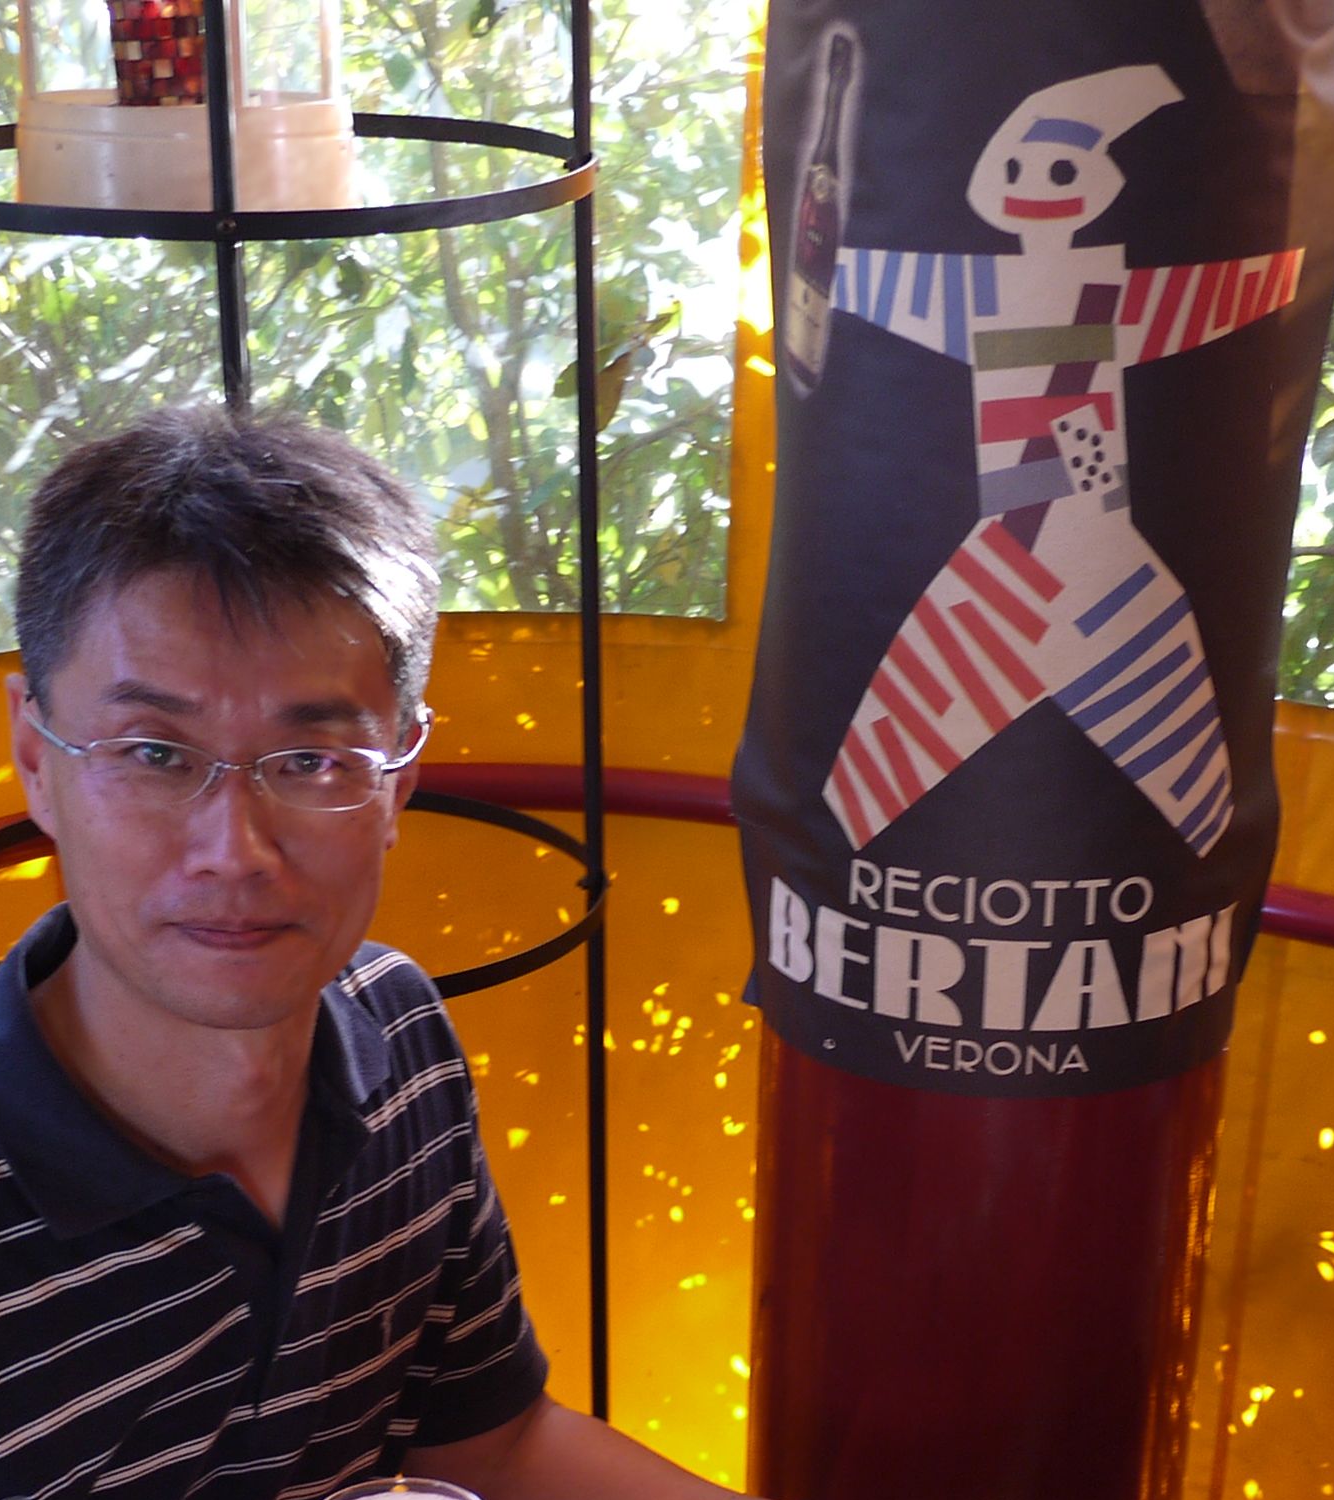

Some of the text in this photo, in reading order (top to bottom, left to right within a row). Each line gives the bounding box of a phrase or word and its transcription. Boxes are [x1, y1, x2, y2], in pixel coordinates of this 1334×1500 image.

[848, 858, 1153, 928] RECIOTTO
[768, 874, 1238, 1032] BERTANI
[894, 1030, 1090, 1076] VERONA
